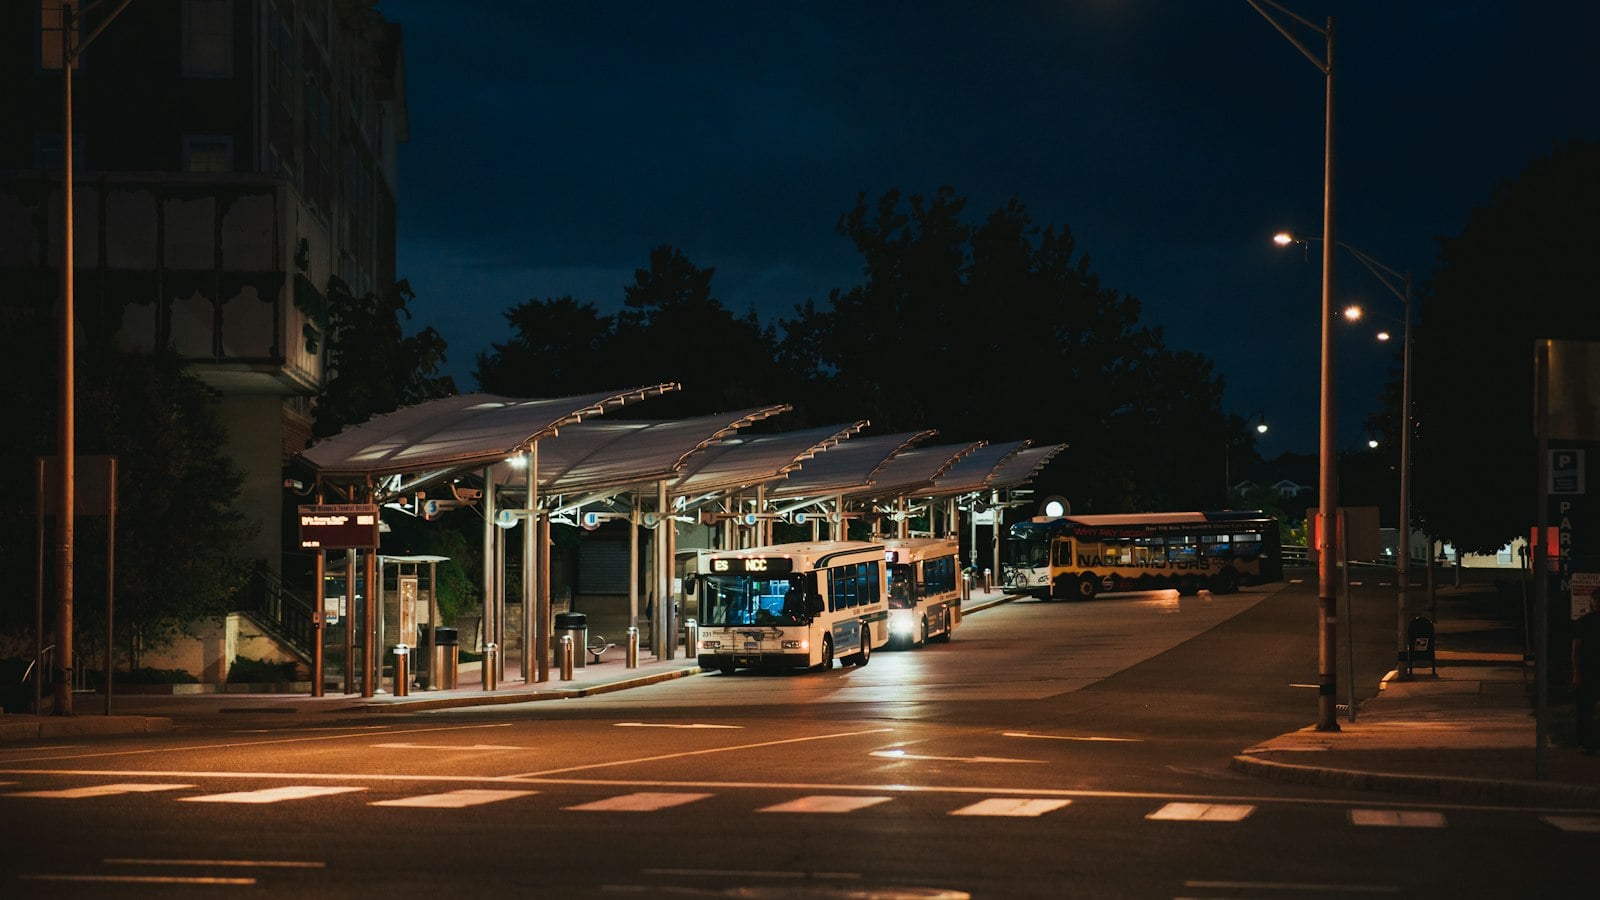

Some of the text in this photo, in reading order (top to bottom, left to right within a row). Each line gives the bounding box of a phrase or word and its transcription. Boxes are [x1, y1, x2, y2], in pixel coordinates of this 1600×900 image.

[1559, 455, 1571, 468] P
[1073, 527, 1098, 536] WHY
[1099, 528, 1117, 537] PAY
[715, 559, 767, 571] ES NCC
